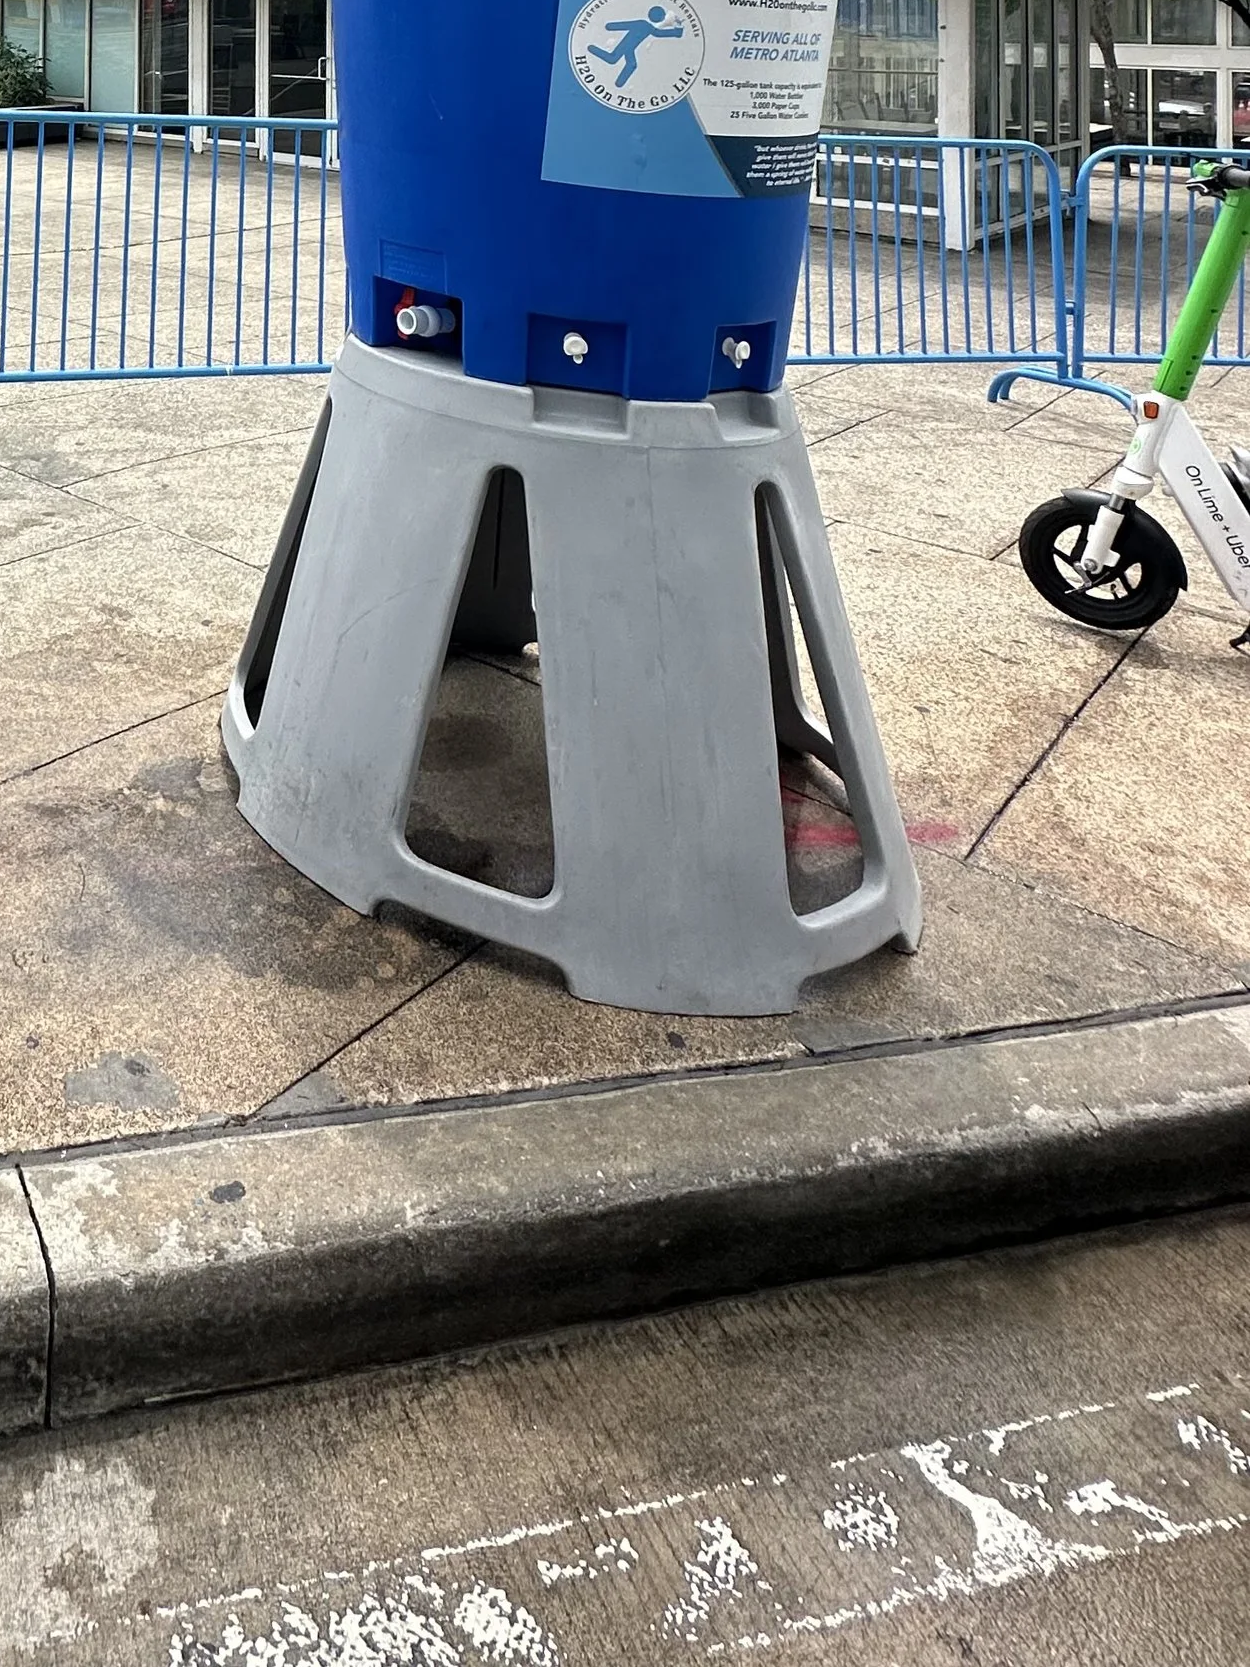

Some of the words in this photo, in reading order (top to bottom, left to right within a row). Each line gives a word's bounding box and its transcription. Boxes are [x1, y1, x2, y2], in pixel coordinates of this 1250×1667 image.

[679, 2, 700, 38] Rentals
[732, 29, 790, 45] SERVING
[791, 32, 810, 46] ALL
[809, 33, 821, 46] OF
[729, 46, 779, 61] METRO
[780, 49, 819, 62] ATLANTA
[594, 84, 613, 102] On
[616, 95, 645, 109] The
[672, 66, 695, 94] LLC
[703, 78, 717, 87] The
[769, 92, 786, 100] Water
[730, 111, 740, 119] 25
[741, 111, 756, 119] Five
[757, 112, 777, 120] Gallon
[1185, 465, 1203, 487] On
[1197, 488, 1224, 523] Lime
[1226, 535, 1250, 568] Uber
